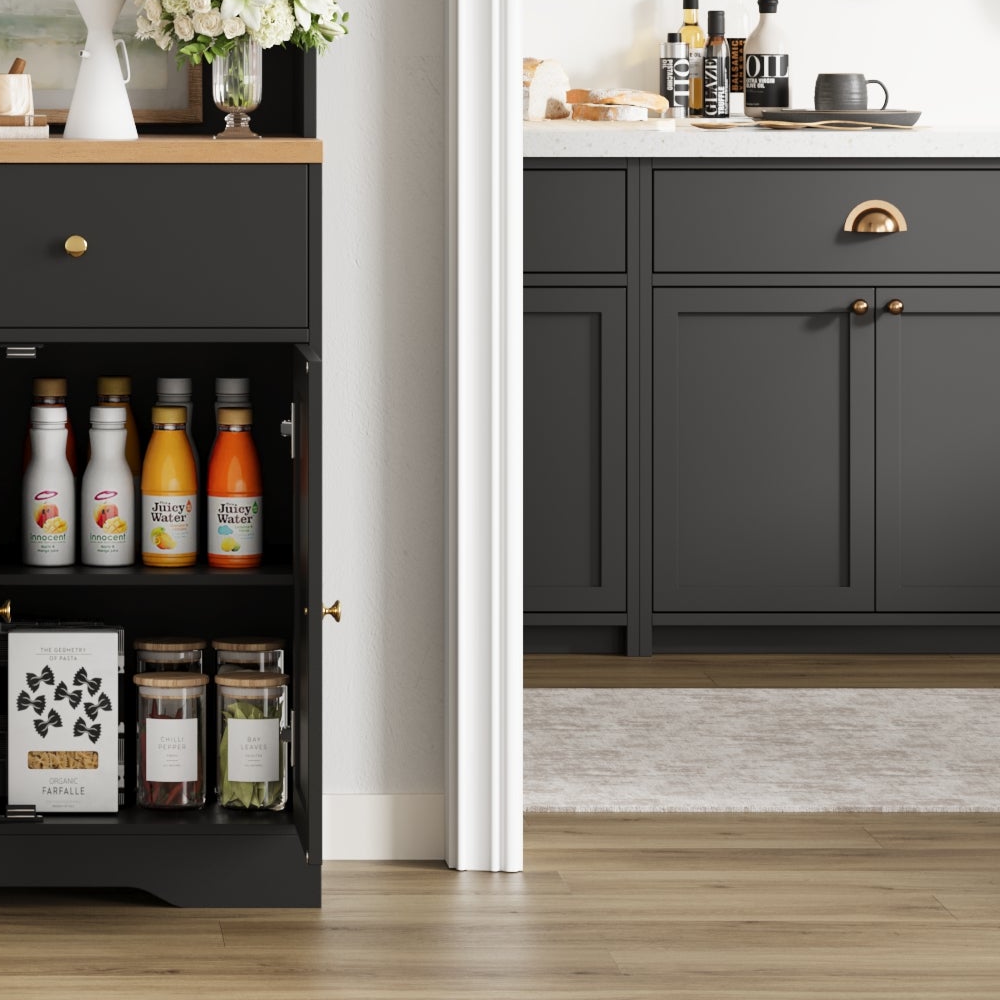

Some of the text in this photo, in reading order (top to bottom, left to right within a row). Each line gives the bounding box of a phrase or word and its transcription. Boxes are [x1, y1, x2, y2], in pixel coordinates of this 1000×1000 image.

[731, 40, 739, 91] BALSAMIC
[746, 54, 789, 78] OIL
[666, 59, 674, 91] PISTACHIO
[673, 58, 690, 107] OIL
[704, 58, 718, 116] GLAZE
[717, 86, 725, 115] TRUFFLE
[151, 502, 186, 515] Juicy
[217, 503, 252, 516] Juicy
[151, 512, 187, 523] Water
[217, 513, 253, 524] Water
[31, 532, 67, 541] innocent
[90, 532, 127, 541] innocent
[48, 777, 79, 785] ORGANIC
[42, 786, 86, 795] FARFALLE
